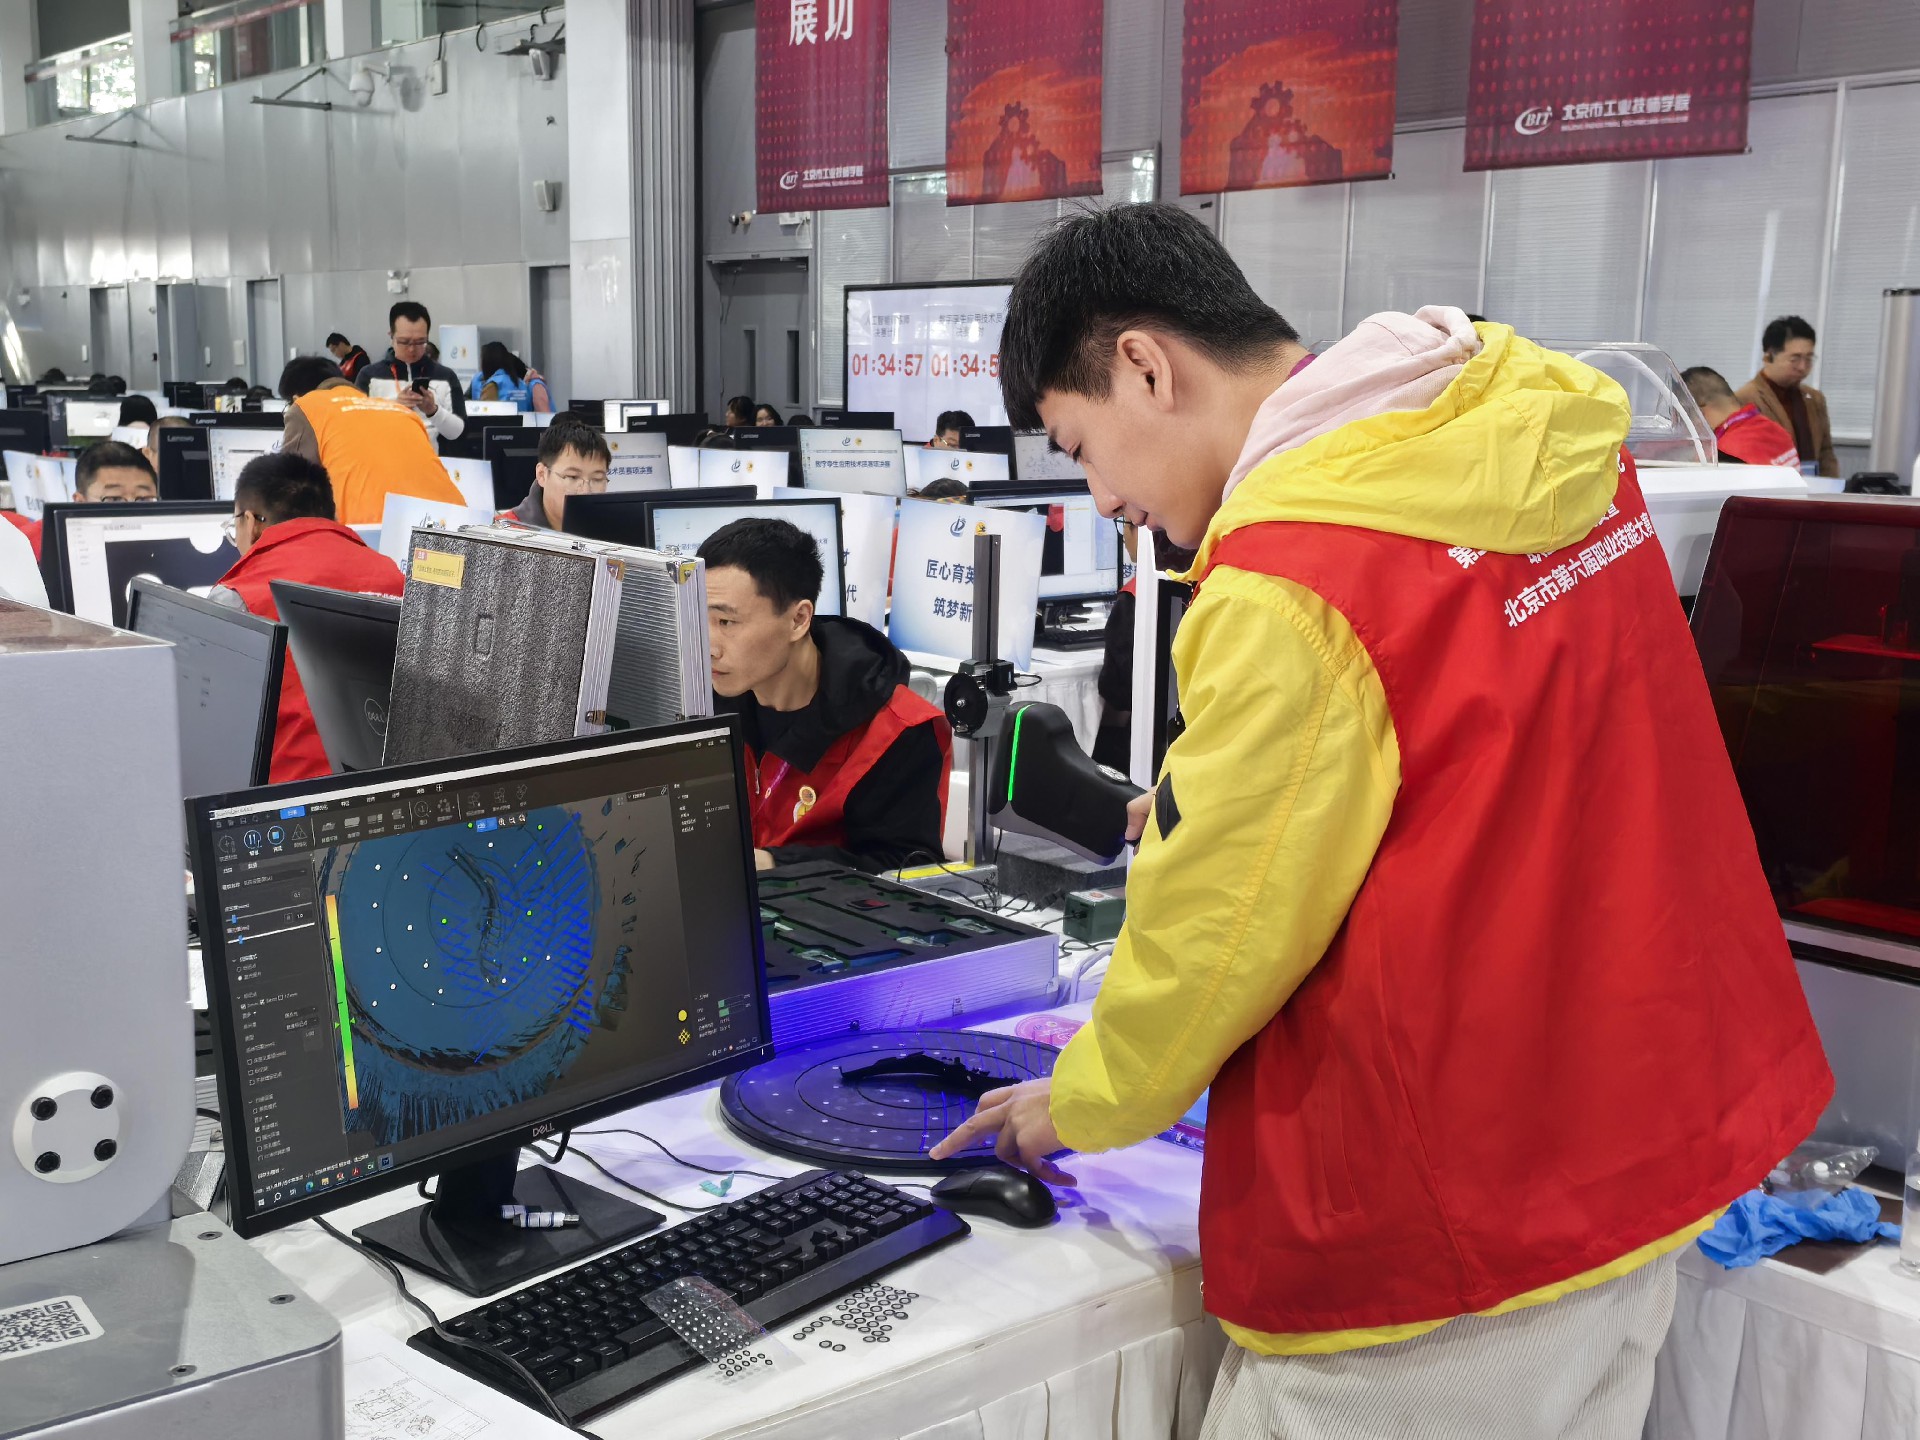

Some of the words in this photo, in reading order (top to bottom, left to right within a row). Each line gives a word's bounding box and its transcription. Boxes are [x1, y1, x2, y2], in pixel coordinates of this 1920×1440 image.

[851, 353, 924, 377] 01:34:57
[931, 353, 1000, 378] 01:34:5
[925, 558, 975, 585] 匠心育英
[933, 596, 973, 623] 筑梦新
[532, 1122, 555, 1138] DELL
